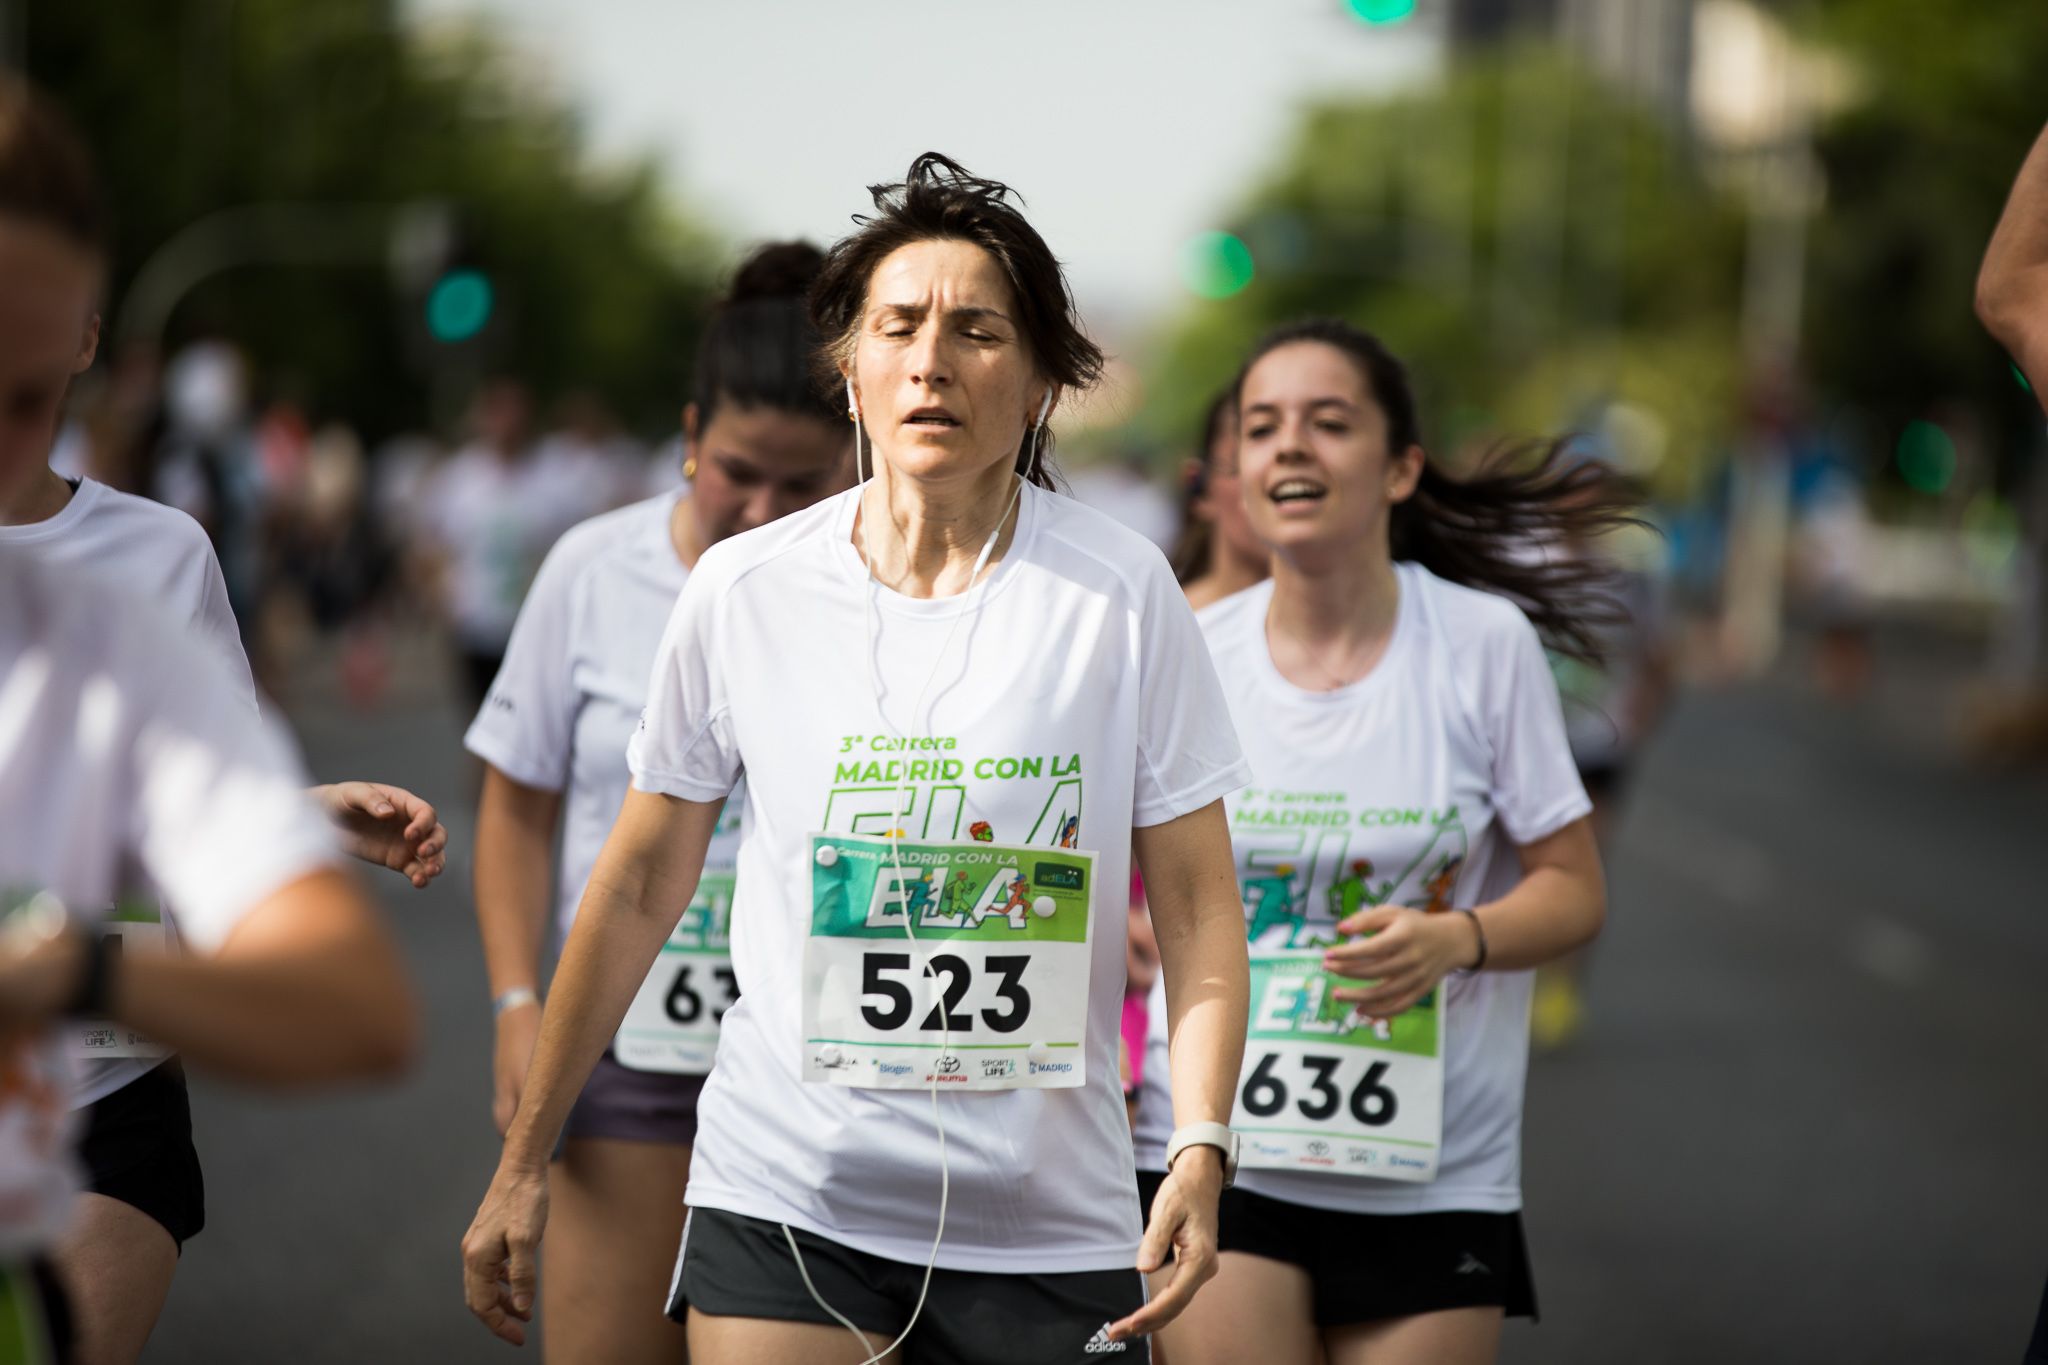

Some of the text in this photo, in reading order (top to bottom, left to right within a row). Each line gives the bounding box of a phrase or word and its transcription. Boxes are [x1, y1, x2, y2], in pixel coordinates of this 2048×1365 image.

[870, 735, 957, 752] Carrera
[834, 753, 1082, 784] MADRID CON LA
[1234, 804, 1461, 827] MADRID CON LA
[880, 851, 950, 866] MADRID
[955, 852, 993, 865] CON
[997, 853, 1019, 866] LA
[864, 866, 1027, 929] ELA
[860, 952, 1032, 1034] 523
[985, 1067, 1006, 1077] LIFE
[1038, 1063, 1073, 1073] MADRID
[1241, 1053, 1399, 1128] 636
[1084, 1341, 1127, 1353] adidas
